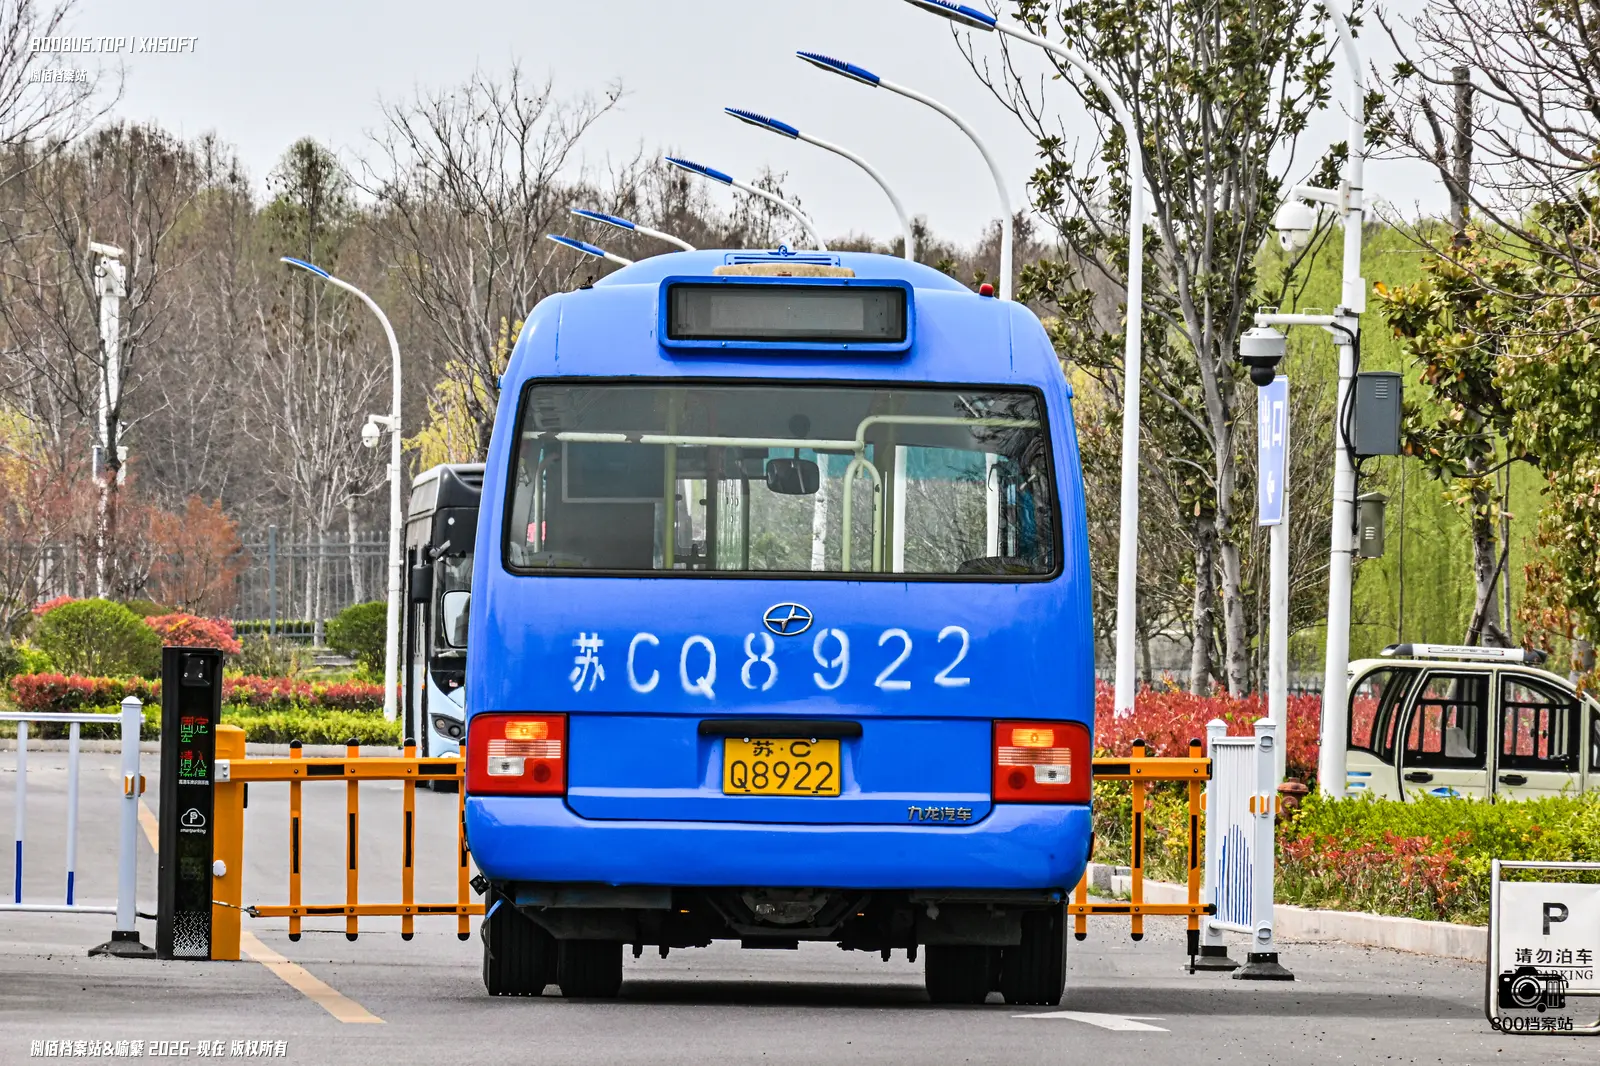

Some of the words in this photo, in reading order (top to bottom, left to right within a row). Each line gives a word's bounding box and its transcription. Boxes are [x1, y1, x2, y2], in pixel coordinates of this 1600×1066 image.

[730, 760, 833, 791] Q8922
[907, 805, 972, 821] 九龙汽车
[1542, 902, 1569, 936] P
[1514, 948, 1593, 964] 请勿泊车
